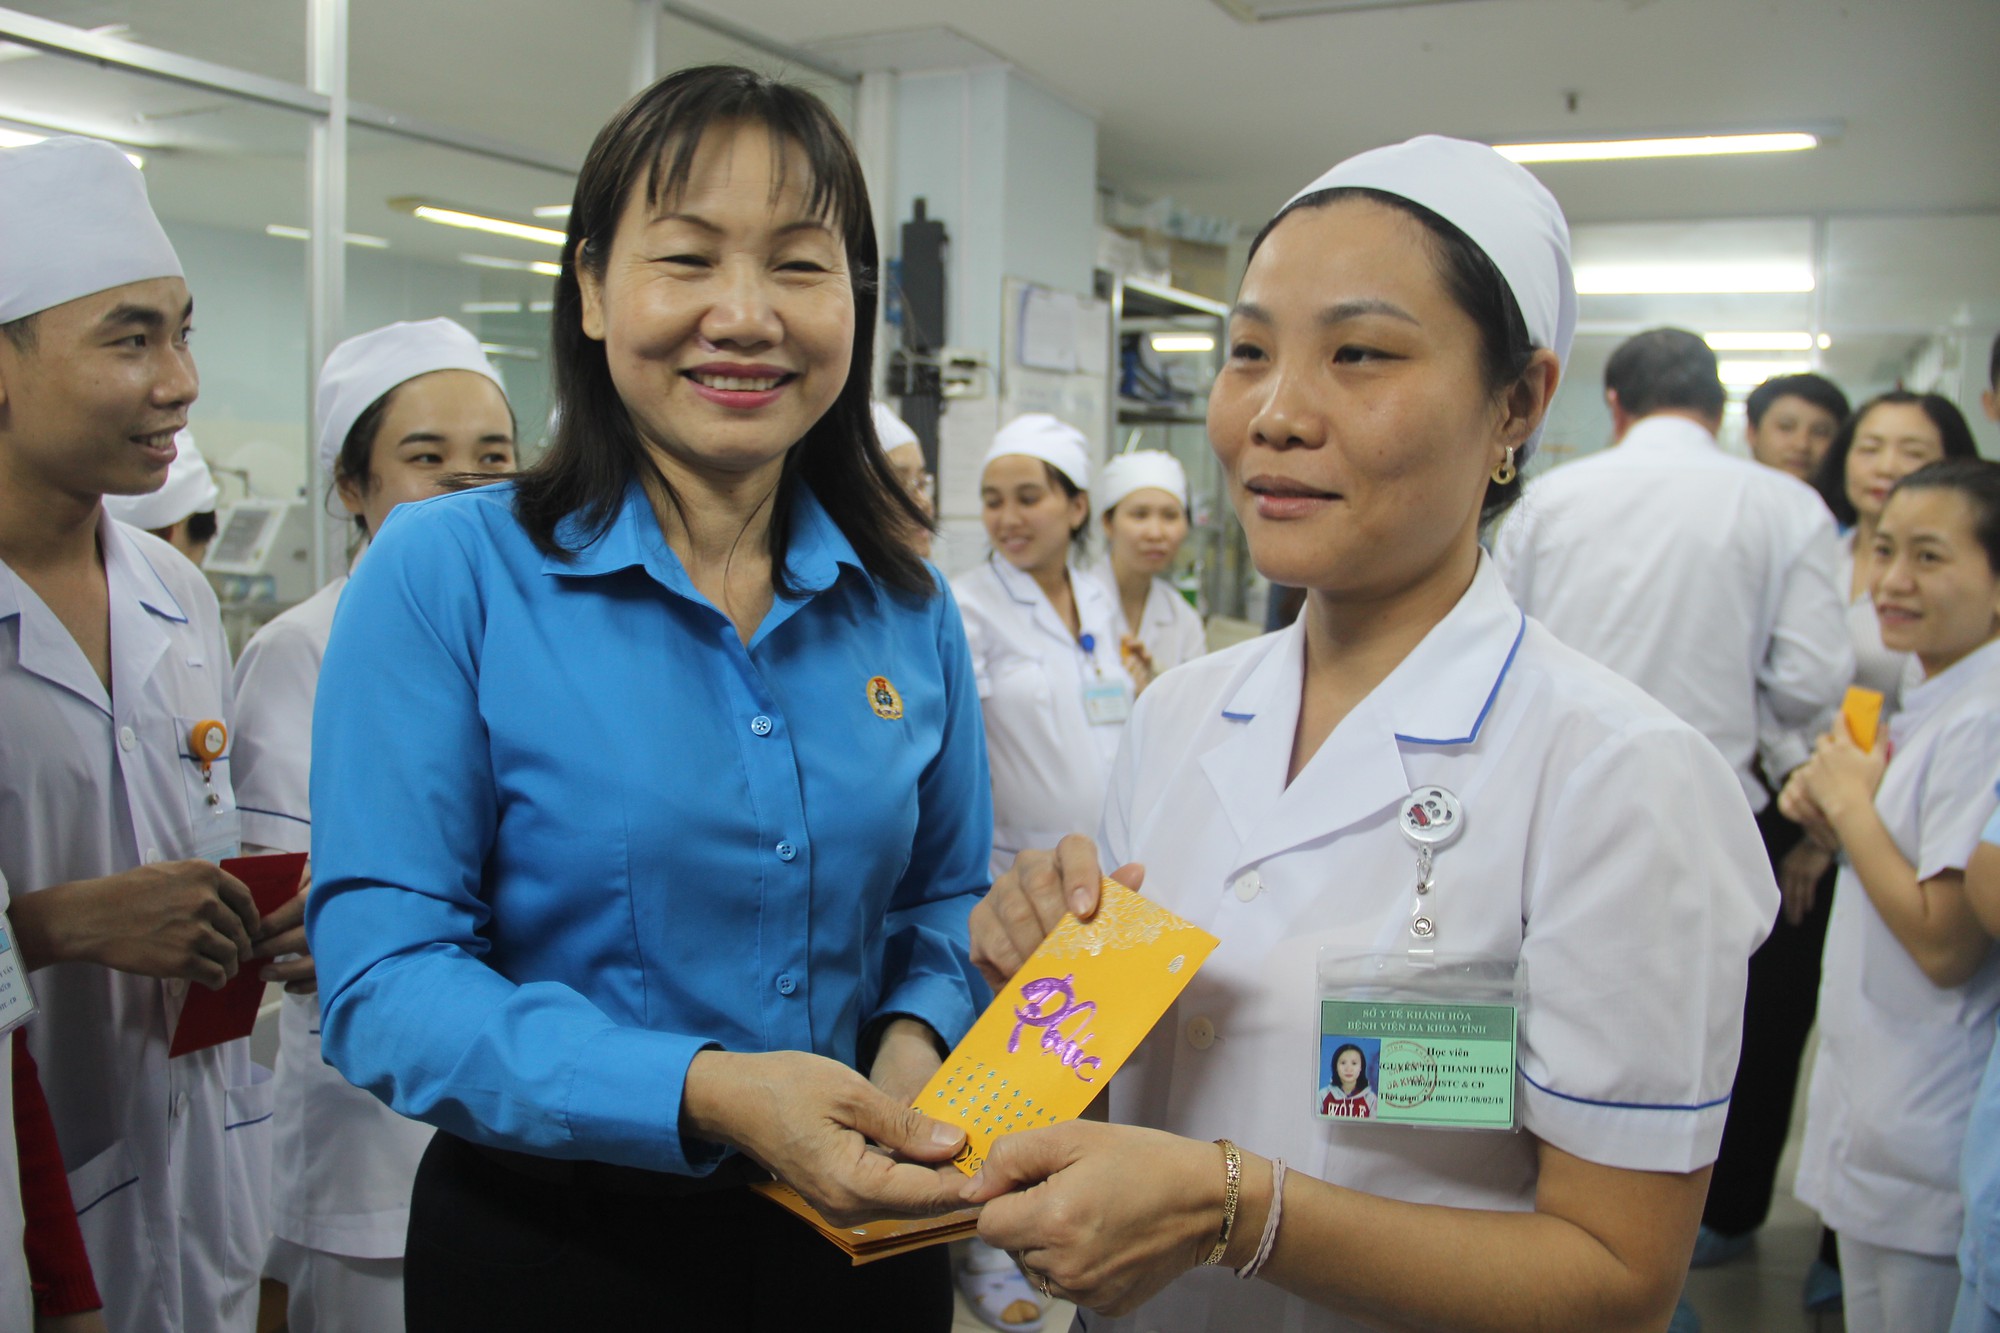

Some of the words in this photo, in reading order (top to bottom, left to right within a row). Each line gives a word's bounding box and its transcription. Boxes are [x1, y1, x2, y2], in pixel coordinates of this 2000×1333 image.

[1362, 1007, 1377, 1019] SỞ
[1379, 1009, 1387, 1019] Y
[1389, 1006, 1404, 1019] TẾ
[1406, 1009, 1446, 1021] KHÁNH
[1448, 1010, 1472, 1021] HÒA
[1347, 1020, 1377, 1031] BỆNH
[1380, 1020, 1406, 1033] VIỆN
[1427, 1023, 1457, 1034] KHOA
[1459, 1022, 1487, 1035] TỈNH
[1427, 1047, 1446, 1058] Học
[1449, 1048, 1469, 1058] viên
[1441, 1065, 1477, 1073] THANH
[1480, 1065, 1509, 1075] THẢO
